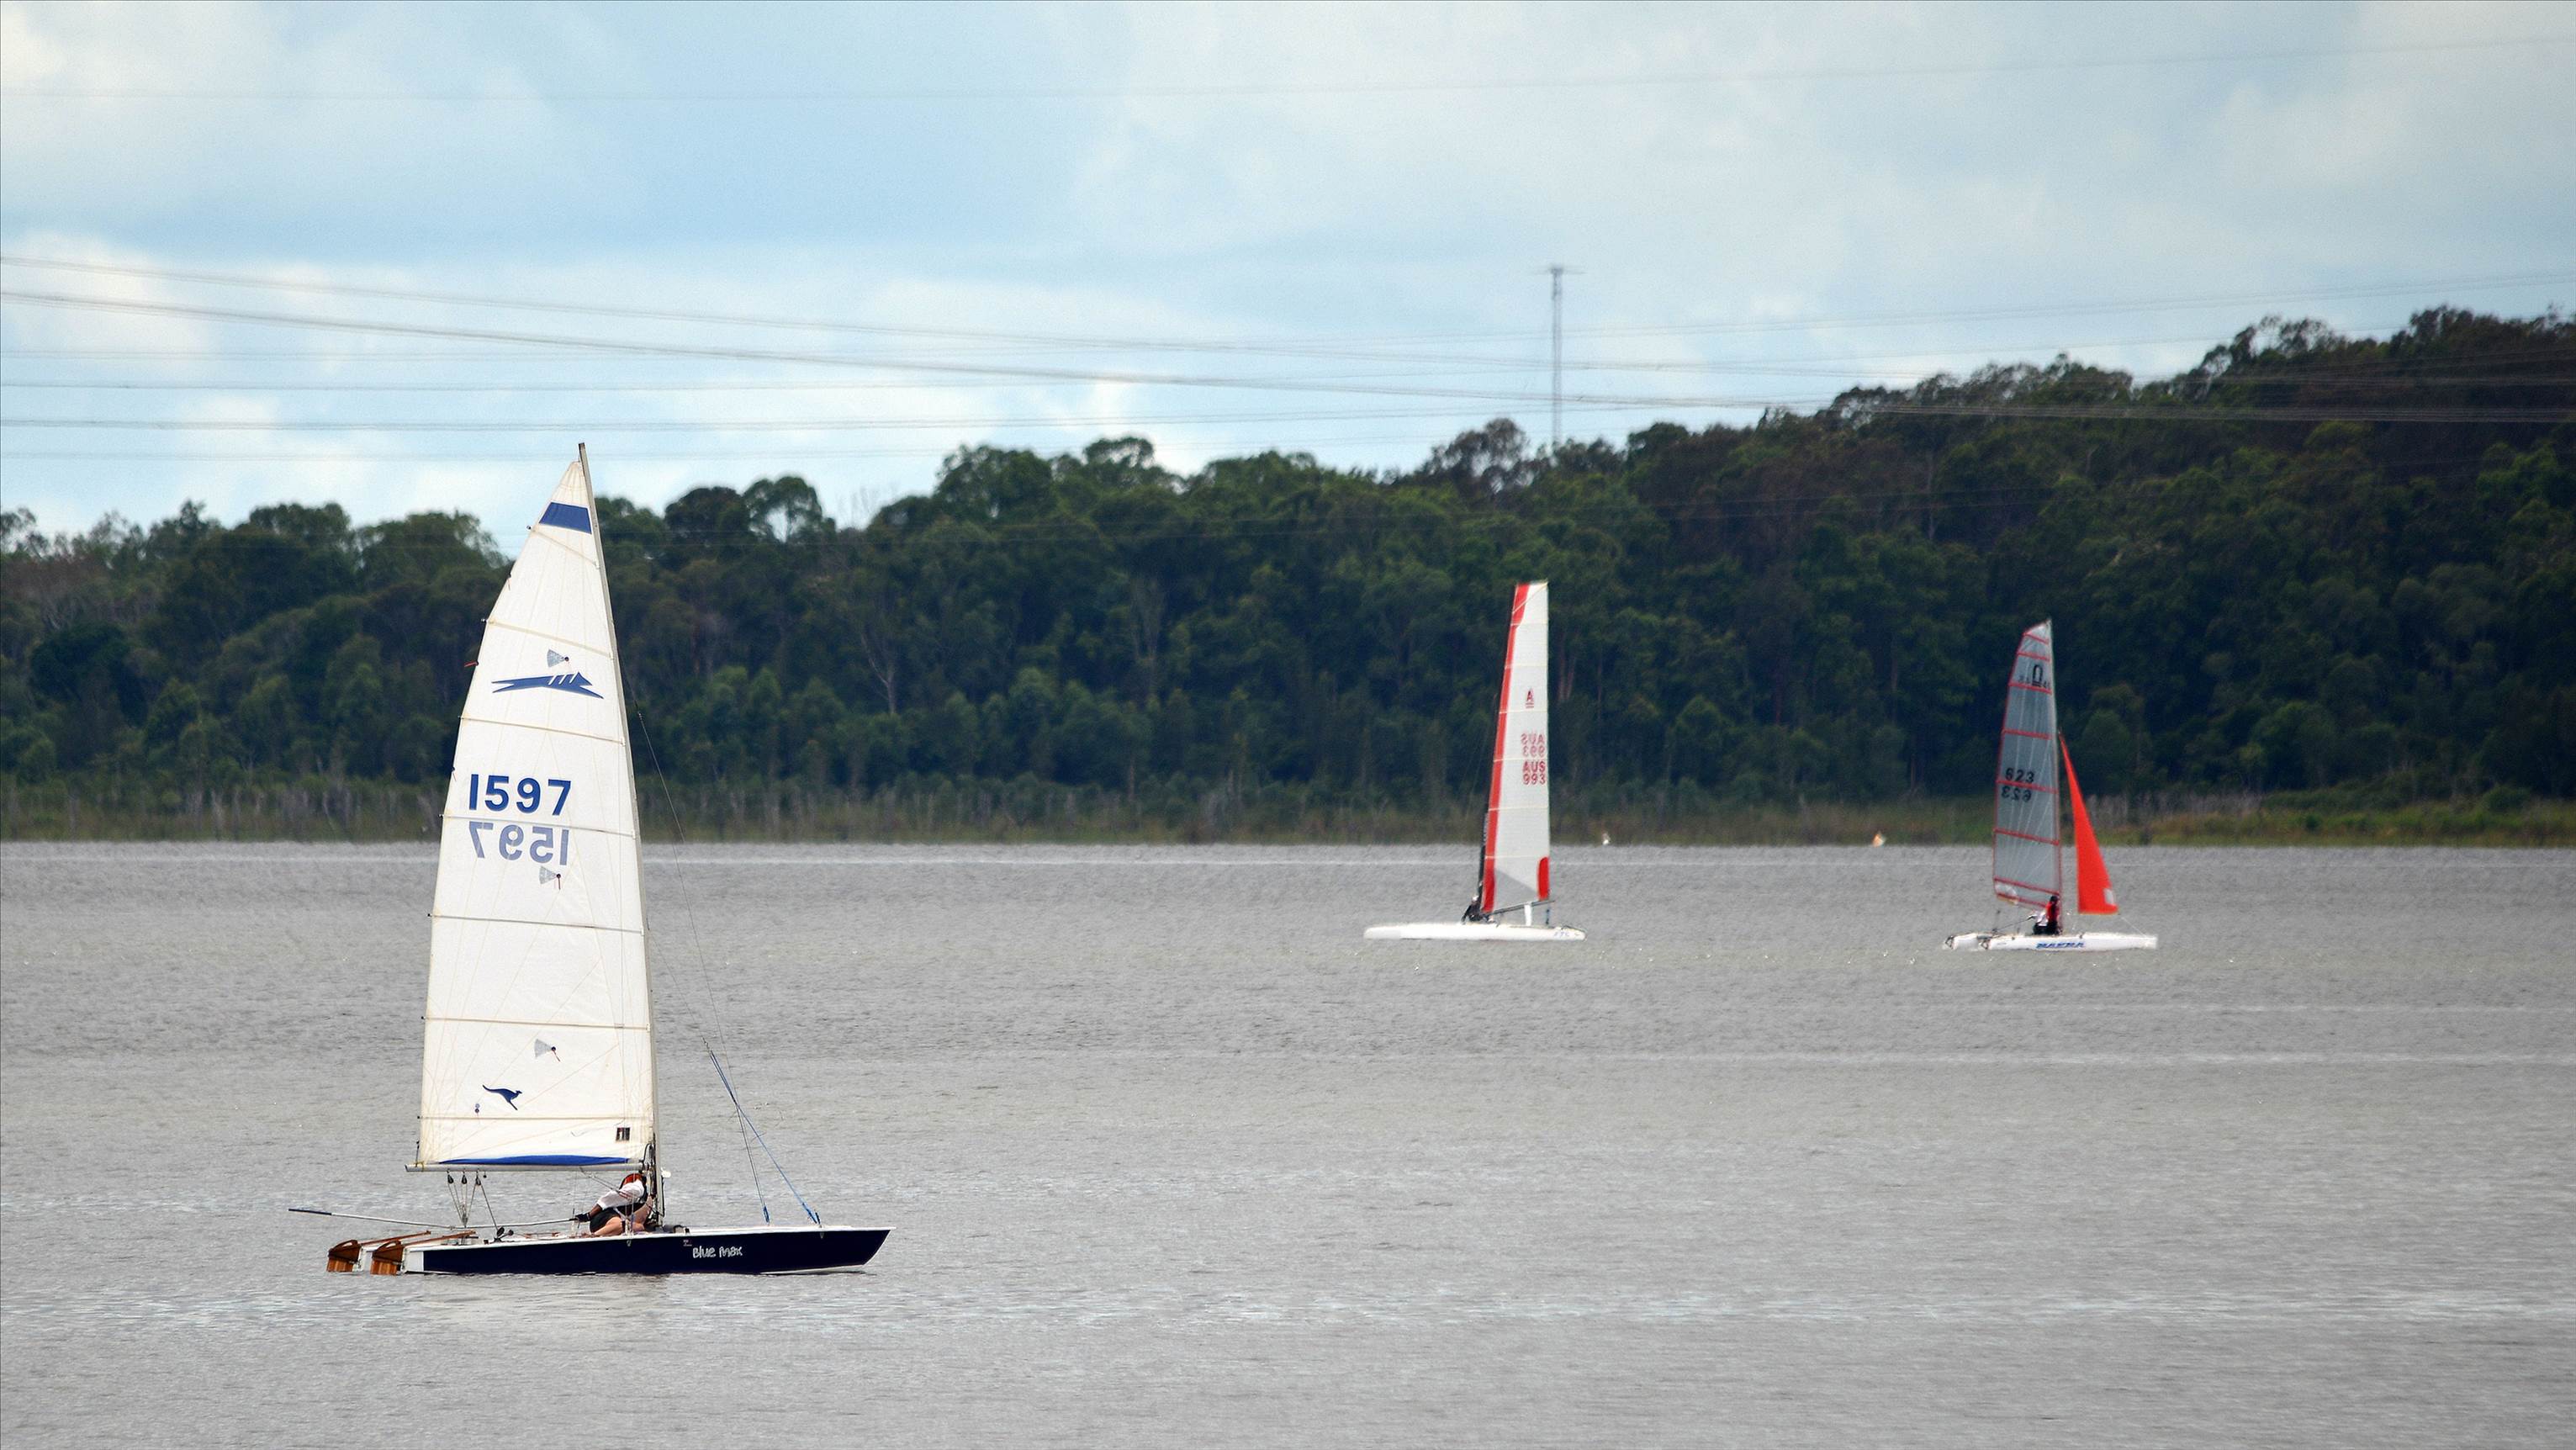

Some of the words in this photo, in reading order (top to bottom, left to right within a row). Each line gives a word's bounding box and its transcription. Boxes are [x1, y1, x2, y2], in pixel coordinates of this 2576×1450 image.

[1522, 760, 1547, 773] AUS
[1522, 773, 1547, 786] 993
[2005, 767, 2035, 784] 623
[468, 773, 572, 817] 1597
[692, 1245, 717, 1259] Blue
